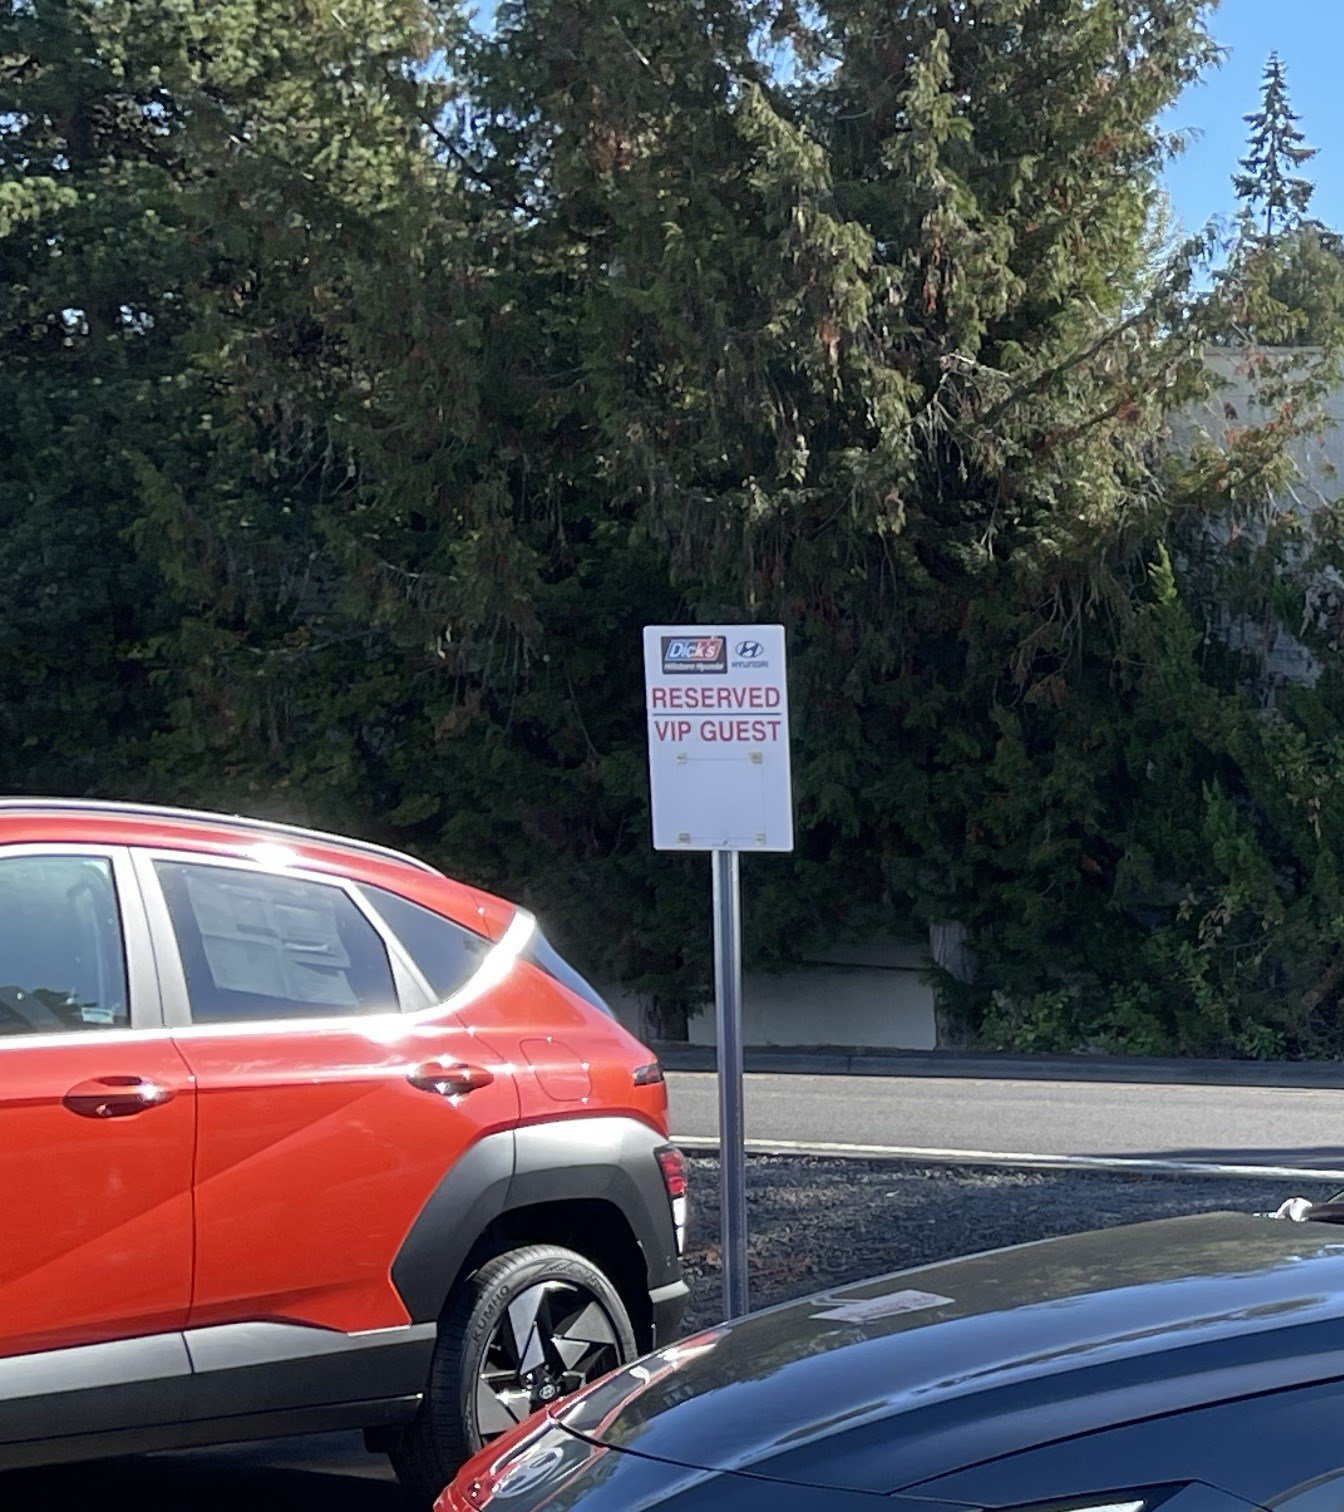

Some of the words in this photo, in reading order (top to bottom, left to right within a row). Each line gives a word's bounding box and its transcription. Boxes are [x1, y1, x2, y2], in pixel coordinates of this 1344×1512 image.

[652, 687, 781, 709] RESERVED
[655, 720, 691, 742] VIP
[700, 720, 781, 742] GUEST
